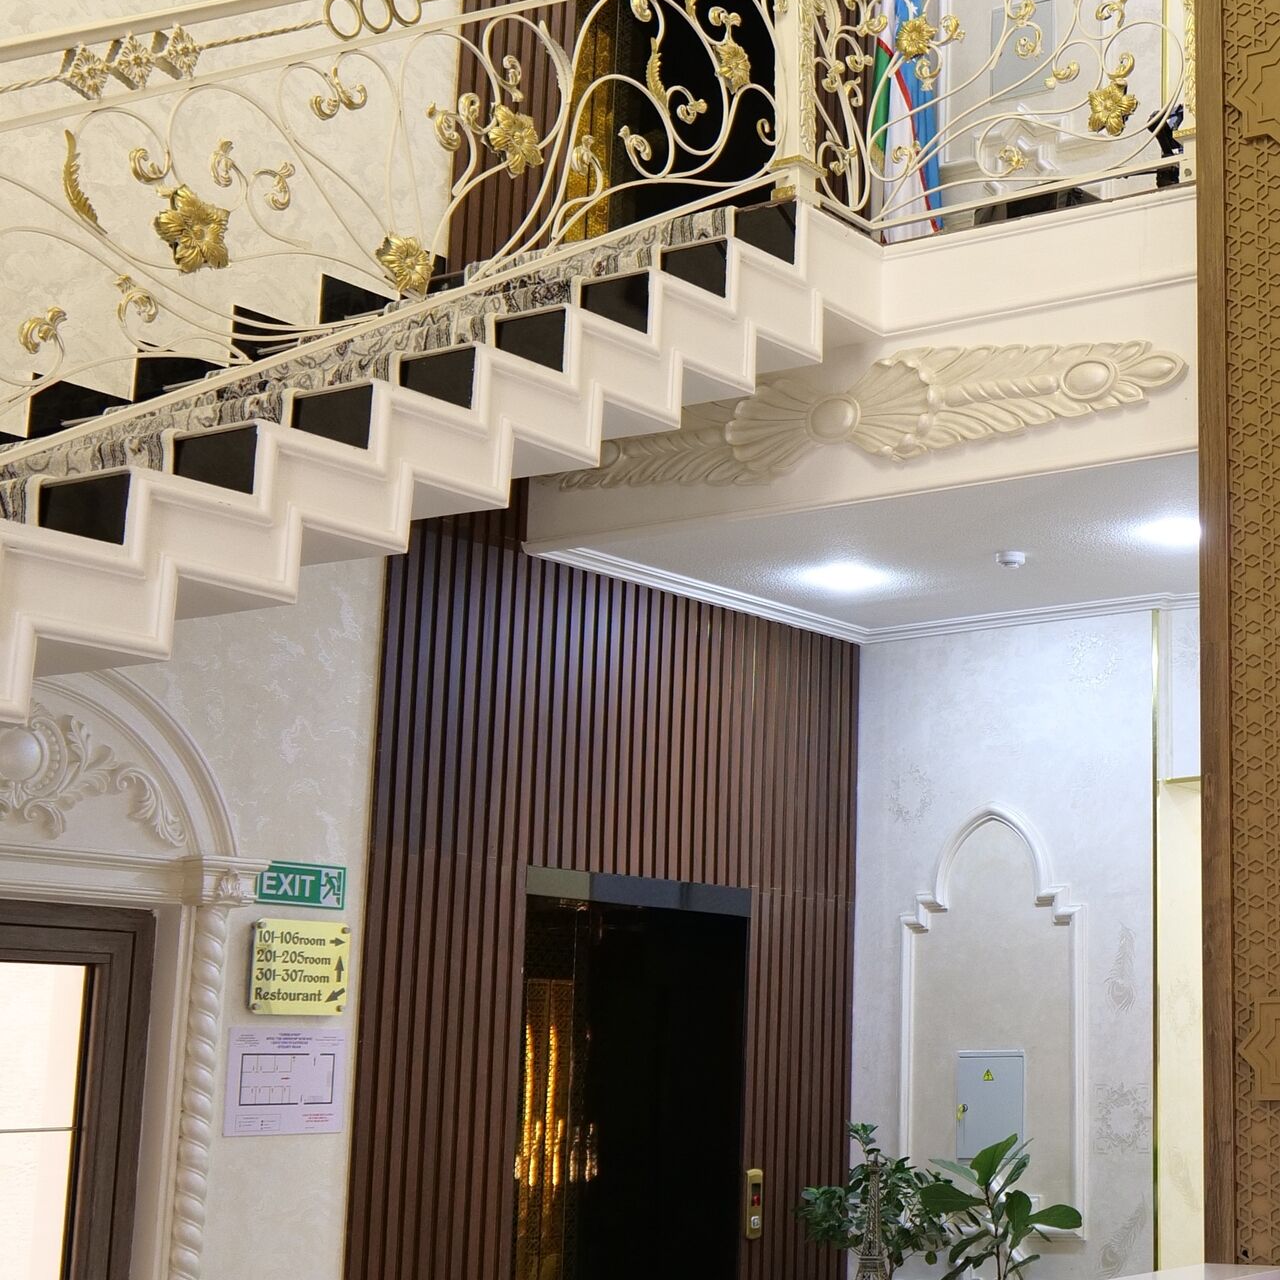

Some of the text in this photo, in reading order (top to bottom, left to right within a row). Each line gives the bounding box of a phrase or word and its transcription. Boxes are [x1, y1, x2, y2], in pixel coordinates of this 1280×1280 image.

[262, 872, 315, 897] EXIT
[258, 930, 326, 946] 101-106room
[256, 948, 331, 965] 201-205room
[255, 968, 329, 983] 301-307room
[255, 987, 322, 1002] Restourant
